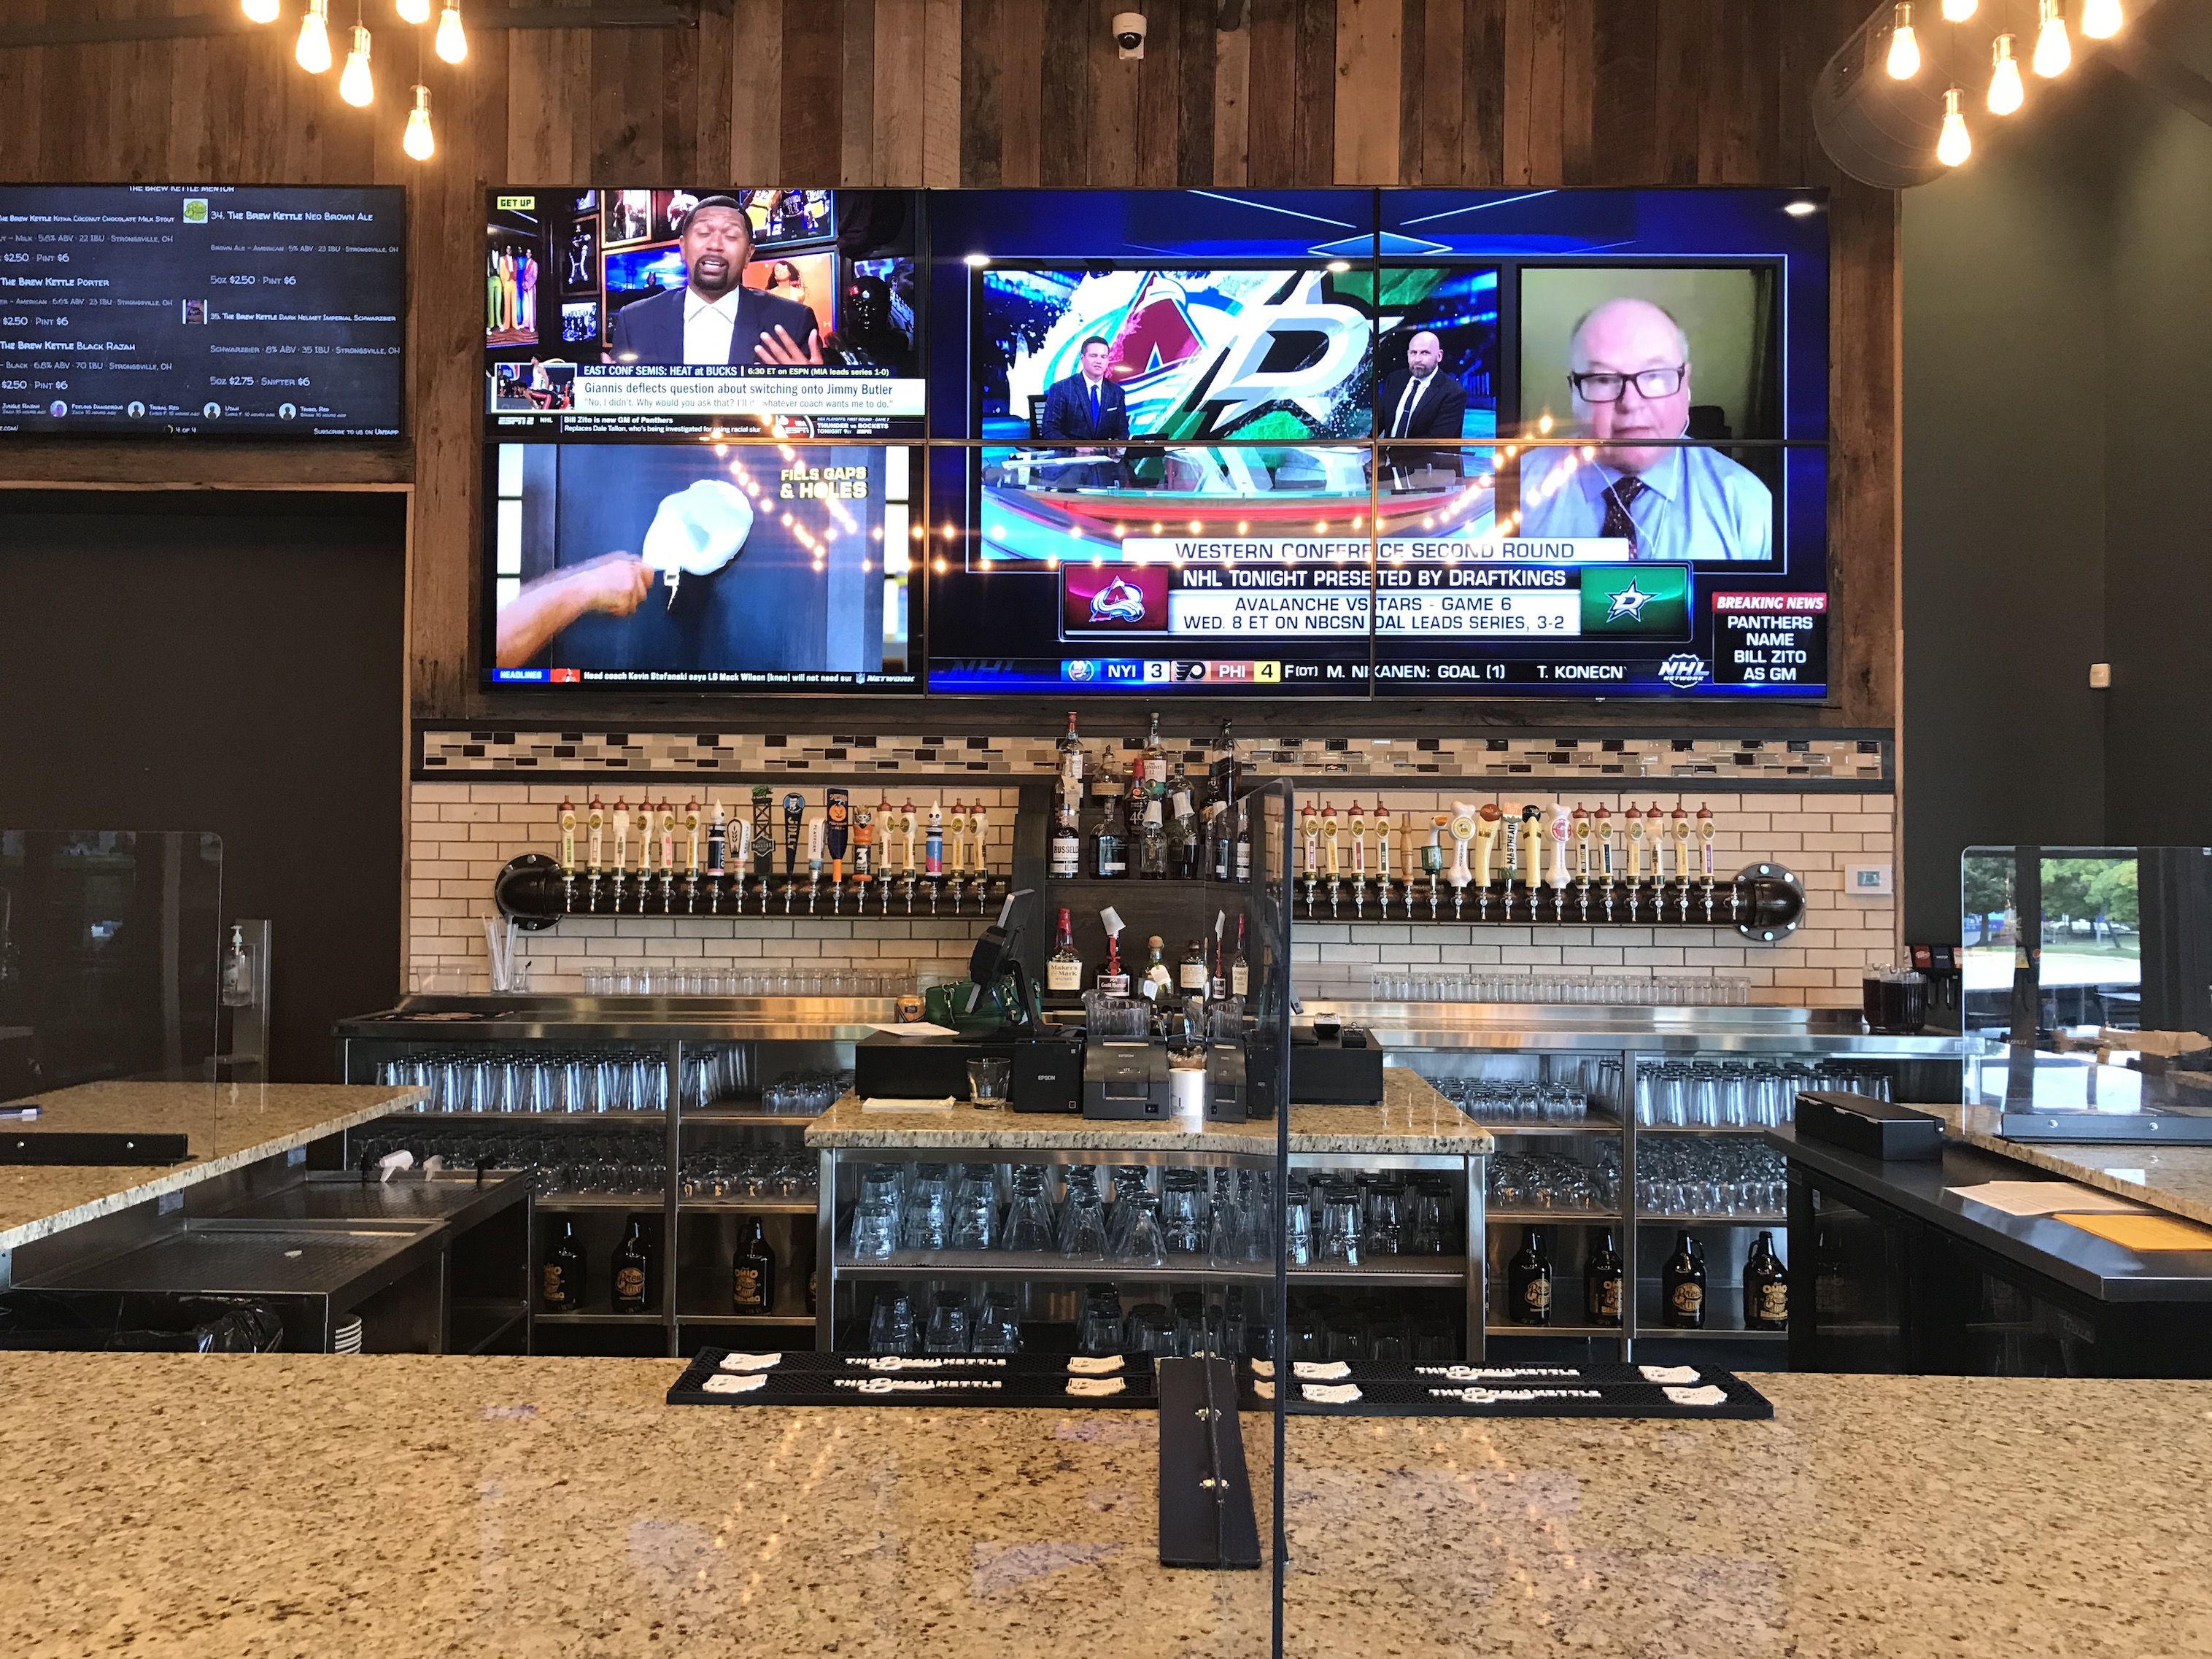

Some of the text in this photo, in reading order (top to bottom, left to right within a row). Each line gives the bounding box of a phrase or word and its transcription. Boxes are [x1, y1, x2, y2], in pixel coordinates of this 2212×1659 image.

[226, 210, 243, 220] THE
[245, 210, 271, 220] BREW
[273, 211, 303, 220] KETTLE
[304, 212, 322, 220] NEO
[324, 212, 355, 220] BROWN
[357, 212, 373, 221] ALE
[1, 276, 109, 286] THE BREW KETTLE PORTER
[0, 340, 15, 349] THE
[18, 340, 42, 349] BREW
[44, 341, 74, 349] KETTLE
[76, 341, 104, 350] BLACK
[584, 366, 738, 376] EAST CONF SEMIS: HEAT at BUCKS
[789, 367, 809, 375] ESPN
[811, 368, 827, 376] (MIA
[874, 368, 889, 376] 1-0)
[584, 382, 892, 396] Giannis deflects question about switching onto Jimmy Butler
[608, 398, 633, 406] didn't.
[636, 398, 652, 408] Why
[655, 398, 678, 406] would
[681, 400, 695, 408] you
[697, 398, 711, 406] ask
[714, 398, 734, 406] that?
[737, 398, 747, 406] I'll
[762, 399, 797, 407] whatever
[866, 400, 874, 408] to
[498, 417, 534, 425] ESPN2
[781, 466, 867, 481] FILLS GAPS
[780, 482, 868, 499] & HOLES
[1175, 543, 1272, 559] WESTERN
[1412, 542, 1494, 559] SECOND
[1502, 542, 1574, 558] ROUND
[1183, 569, 1223, 587] NHL
[1229, 569, 1308, 587] TONIGHT
[1418, 570, 1443, 586] BY
[1449, 569, 1566, 587] DRAFTKINGS
[1235, 597, 1511, 611] AVALANCHE VS TARS GAME 6
[1717, 596, 1823, 609] BREAKING NEWS
[1183, 616, 1224, 628] WED.
[1232, 616, 1241, 628] 8
[1249, 616, 1268, 628] ET
[1275, 616, 1297, 629] ON
[1305, 615, 1364, 628] NBCSN
[1412, 616, 1462, 628] LEADS
[1469, 616, 1528, 632] SERIES,
[1537, 616, 1563, 628] 3-2
[1728, 615, 1812, 629] PANTHERS
[1746, 633, 1794, 646] NAME
[1734, 649, 1806, 663] BILL ZITO
[500, 670, 542, 679] HEADLINES
[1108, 665, 1136, 678] NYI
[1151, 663, 1162, 678] 3
[1219, 665, 1245, 678] PHI
[1261, 664, 1273, 678] 4
[1326, 665, 1345, 678] M.
[1437, 665, 1481, 678] GOAL
[1486, 664, 1505, 679] (1)
[1536, 665, 1549, 678] T.
[1555, 665, 1627, 679] KONECN
[1658, 661, 1710, 677] NHL
[1743, 667, 1795, 680] AS GM
[584, 671, 603, 679] Head
[603, 671, 627, 679] coach
[627, 671, 649, 680] Kevin
[650, 672, 687, 680] Stefanski
[688, 673, 706, 681] says
[708, 672, 718, 681] LB
[719, 672, 739, 681] Mack
[740, 673, 765, 681] Wilson
[767, 673, 790, 682] (knee)
[792, 673, 805, 681] will
[820, 673, 838, 681] need
[840, 673, 852, 681] sur
[1129, 808, 1145, 825] 46
[1507, 824, 1516, 865] MASTHEAD
[936, 1380, 1002, 1388] KETTLE
